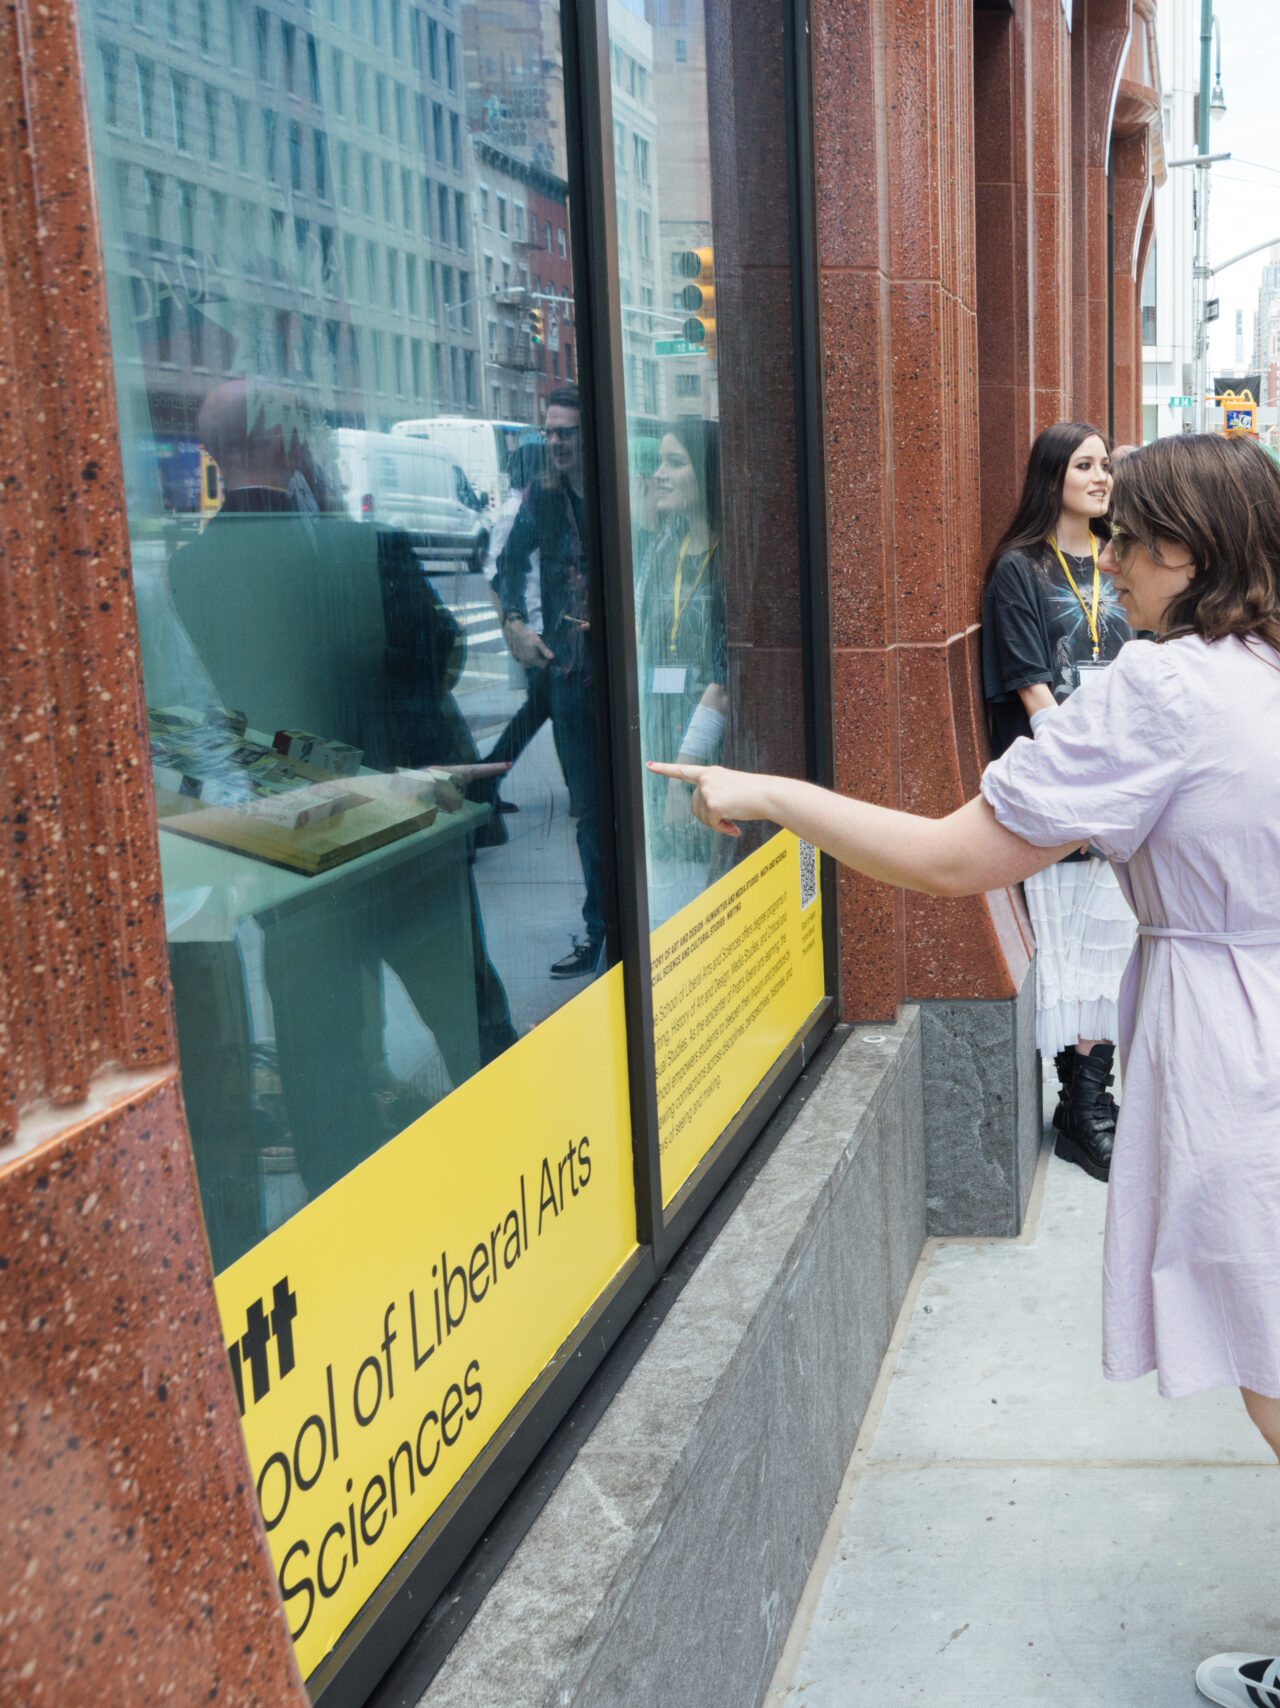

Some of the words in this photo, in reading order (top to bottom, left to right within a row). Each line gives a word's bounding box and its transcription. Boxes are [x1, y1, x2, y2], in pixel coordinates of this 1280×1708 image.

[662, 954, 681, 978] SCIENCE
[681, 946, 691, 961] AND
[690, 931, 710, 953] CULTURAL
[710, 916, 726, 936] STUDIES
[726, 901, 742, 920] WRITING
[664, 947, 671, 960] OF
[671, 939, 680, 955] ART
[679, 932, 689, 947] AND
[688, 920, 704, 939] DESIGN
[705, 900, 728, 924] HUMANITIES
[727, 893, 736, 906] AND
[735, 885, 746, 899] MEDIA
[745, 873, 759, 891] STUDIES
[659, 996, 678, 1022] School
[678, 984, 685, 1003] of
[685, 973, 702, 997] Liberal
[702, 963, 713, 980] Arts
[712, 951, 722, 971] and
[721, 935, 742, 962] Sciences
[741, 924, 753, 943] offers
[671, 1011, 690, 1036] History
[690, 998, 696, 1018] of
[696, 994, 705, 1009] Art
[704, 982, 714, 1003] and
[689, 1028, 697, 1041] As
[696, 1019, 705, 1036] the
[704, 996, 727, 1027] epicenter
[726, 986, 732, 1004] of
[671, 1051, 699, 1088] empowers
[698, 1028, 719, 1058] students
[675, 1066, 707, 1109] connections
[706, 1049, 722, 1074] across
[668, 1123, 675, 1144] of
[675, 1107, 693, 1136] seeing
[692, 1092, 703, 1115] and
[256, 1364, 340, 1533] ool
[353, 1301, 396, 1428] of
[408, 1173, 529, 1372] Liberal
[538, 1135, 592, 1237] Arts
[278, 1359, 483, 1644] Sciences
